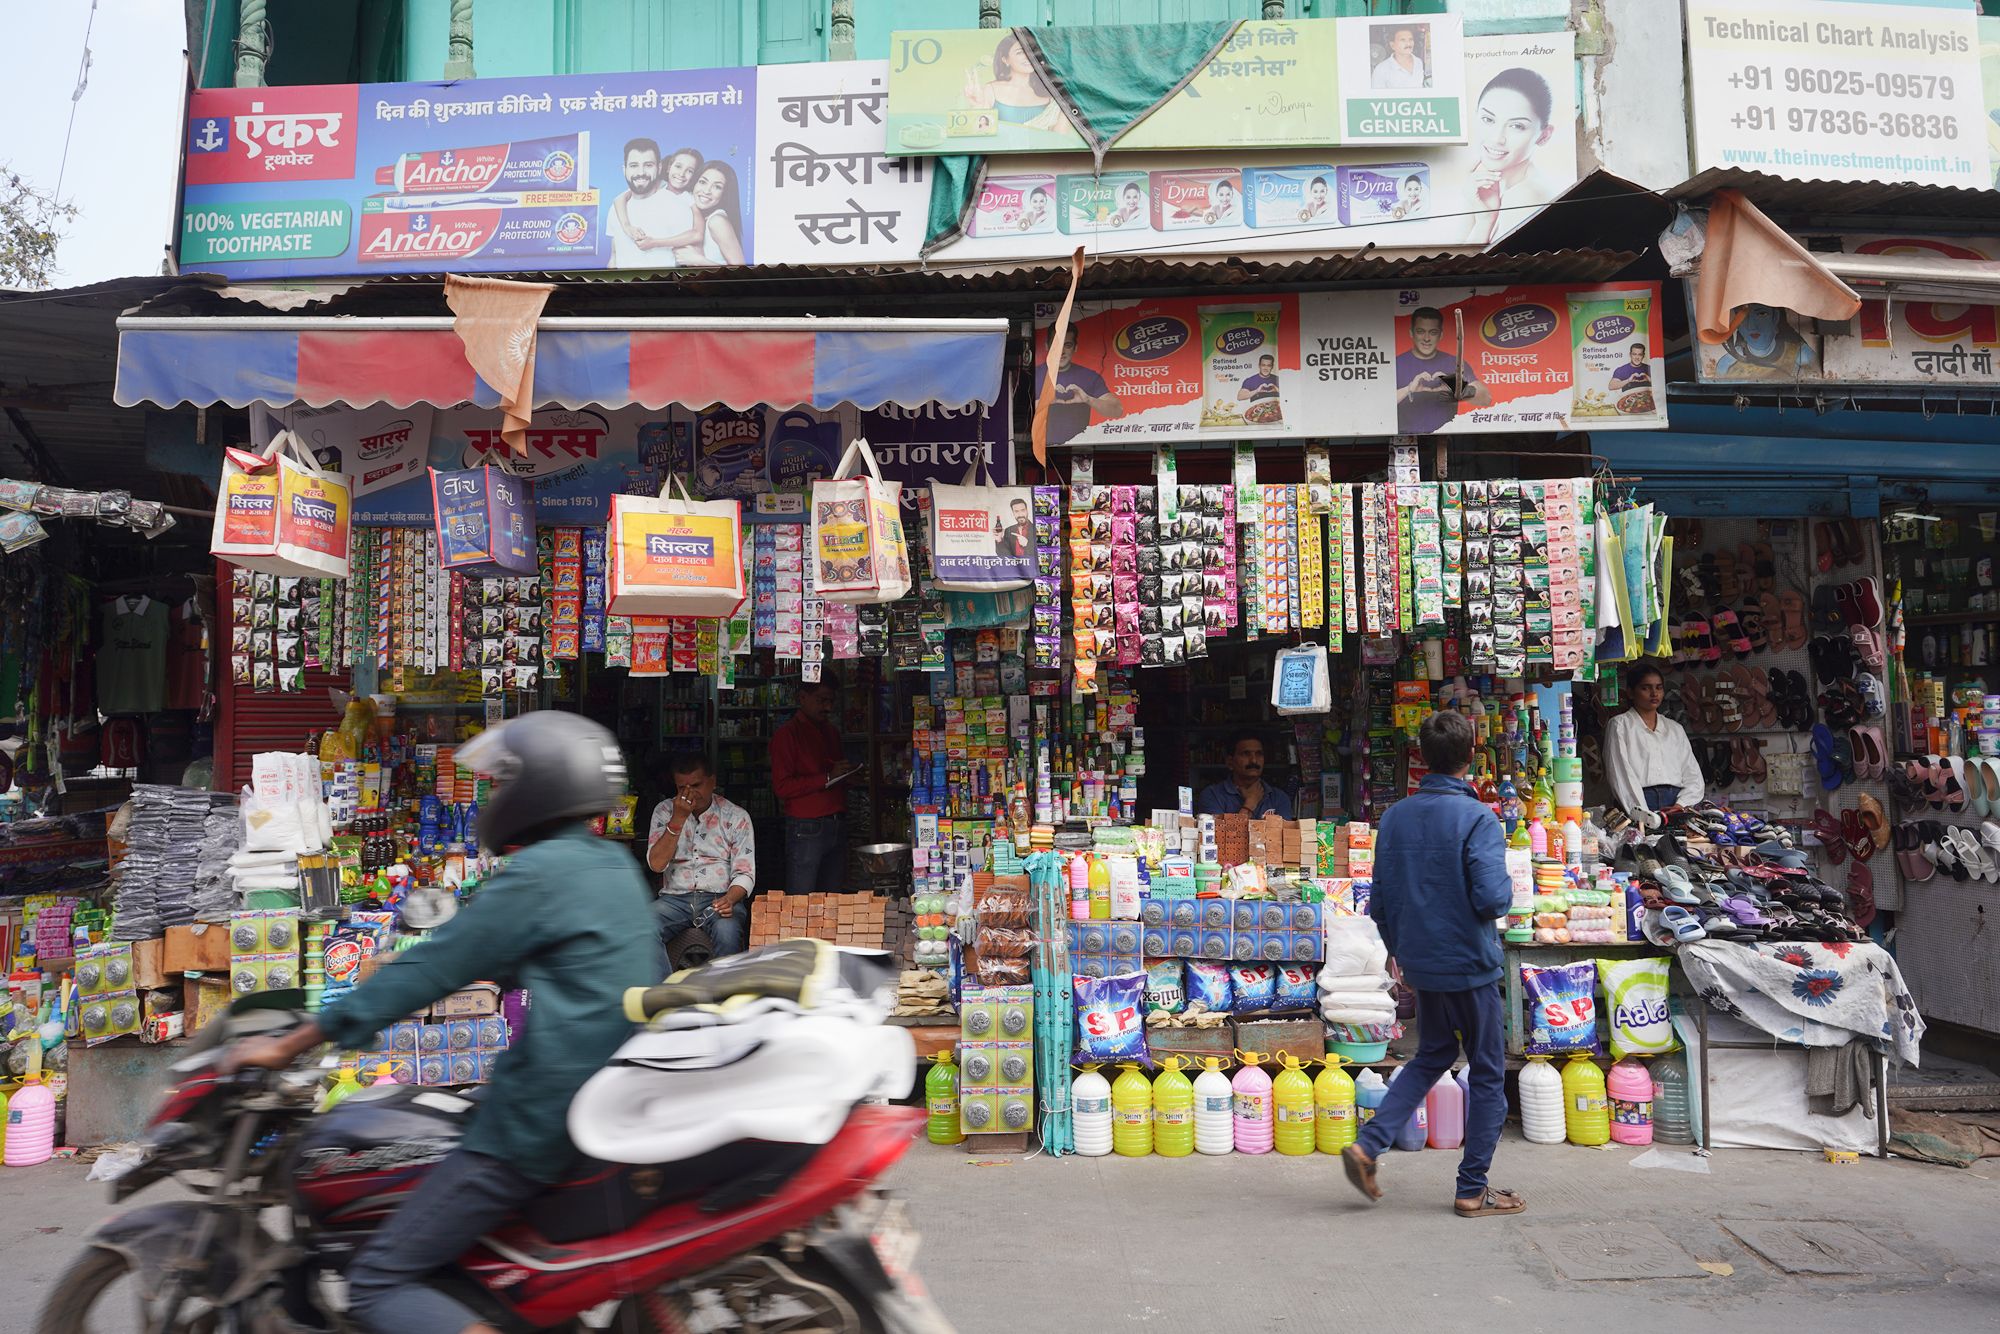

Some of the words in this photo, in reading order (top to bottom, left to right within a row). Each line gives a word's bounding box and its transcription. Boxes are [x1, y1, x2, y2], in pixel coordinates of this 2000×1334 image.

[1258, 28, 1298, 46] मिले
[1704, 16, 1809, 43] Technical
[1816, 22, 1874, 47] Chart
[1881, 26, 1969, 55] Analysis
[895, 38, 943, 73] JO
[1475, 51, 1501, 59] product
[1521, 46, 1555, 55] Anchor
[1727, 65, 1774, 91] +91
[1785, 67, 1955, 101] 96025-09579
[376, 102, 405, 121] दिन
[408, 99, 430, 119] की
[433, 100, 493, 122] शुरुआत
[497, 94, 552, 115] कीजिये
[560, 97, 586, 114] एक
[594, 90, 627, 113] सेहत
[630, 89, 657, 110] भरी
[661, 91, 718, 113] मुस्कान
[778, 78, 888, 128] बजरं
[1369, 102, 1437, 116] YUGAL
[234, 102, 342, 159] एंकर
[1359, 119, 1450, 134] GENERAL
[1730, 105, 1776, 131] +91
[1788, 107, 1959, 140] 97836-36836
[264, 153, 314, 171] टूथपेस्ट
[518, 160, 543, 169] ROUND
[1722, 148, 1972, 174] www.theinvestmentpoint.in
[407, 158, 498, 184] Anchor
[503, 169, 542, 178] PROTECTION
[525, 193, 547, 203] FREE
[1073, 188, 1112, 204] Dyna
[1167, 185, 1205, 203] Dyna
[1260, 181, 1300, 200] Dyna
[1355, 180, 1393, 198] Dyna
[980, 192, 1018, 206] Dyna
[185, 212, 234, 233] 100%
[241, 210, 343, 231] VEGETARIAN
[454, 221, 477, 229] White
[504, 221, 520, 230] ALL
[522, 219, 551, 230] ROUND
[794, 198, 902, 247] स्टोर
[366, 225, 482, 253] Anchor
[499, 229, 552, 241] PROTECTION
[207, 234, 312, 255] TOOTHPASTE
[1500, 309, 1535, 327] बेस्ट
[1597, 317, 1621, 329] Best
[1133, 322, 1168, 340] बेस्ट
[1227, 329, 1251, 341] Best
[1499, 322, 1549, 342] चॉइस
[1595, 326, 1631, 340] Choice
[1131, 333, 1181, 355] चॉइस
[1225, 337, 1261, 352] Choice
[1318, 336, 1377, 351] YUGAL
[1306, 352, 1391, 366] GENERAL
[1481, 351, 1538, 366] रिफाइन्ड
[1912, 344, 1968, 376] दादी
[1971, 345, 1992, 376] माँ
[1114, 364, 1170, 378] रिफाइन्ड
[1319, 367, 1378, 381] STORE
[1482, 368, 1542, 384] सोयाबीन
[1545, 368, 1568, 383] तेल
[1115, 381, 1173, 397] सोयाबीन
[1176, 380, 1199, 395] तेल
[360, 428, 412, 451] सारस
[701, 418, 760, 446] Saras
[463, 428, 606, 459] सरस
[874, 441, 996, 465] जनरल
[230, 495, 274, 509] सिल्वर
[292, 496, 336, 523] सिल्वर
[542, 497, 568, 506] Since
[569, 496, 592, 505] 1975
[649, 536, 709, 555] सिल्वर
[677, 557, 707, 565] मसाला
[940, 557, 955, 566] अब
[325, 953, 360, 968] Roopam
[1545, 997, 1593, 1026] SP
[1615, 998, 1671, 1028] Aala
[1087, 1007, 1135, 1036] SP
[1549, 1023, 1582, 1033] DETERGENT
